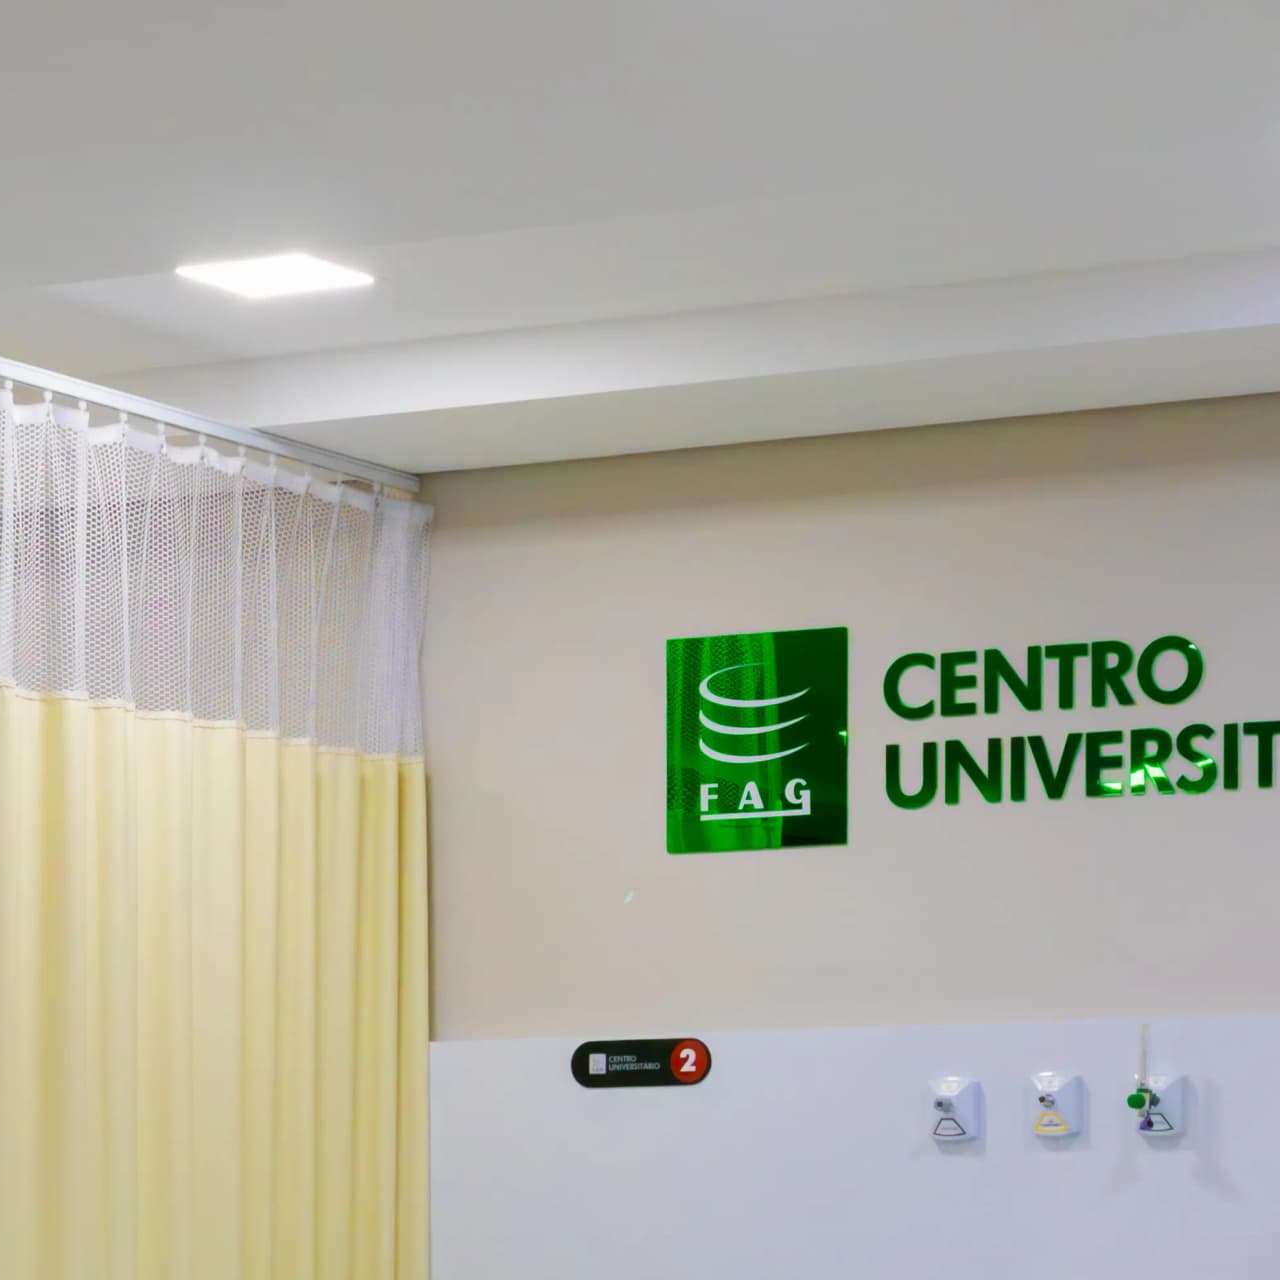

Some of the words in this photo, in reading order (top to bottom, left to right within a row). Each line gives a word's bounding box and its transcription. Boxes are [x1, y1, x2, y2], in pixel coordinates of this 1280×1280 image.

[883, 635, 1205, 721] CENTRO
[700, 777, 811, 816] FAG
[679, 1048, 697, 1072] 2
